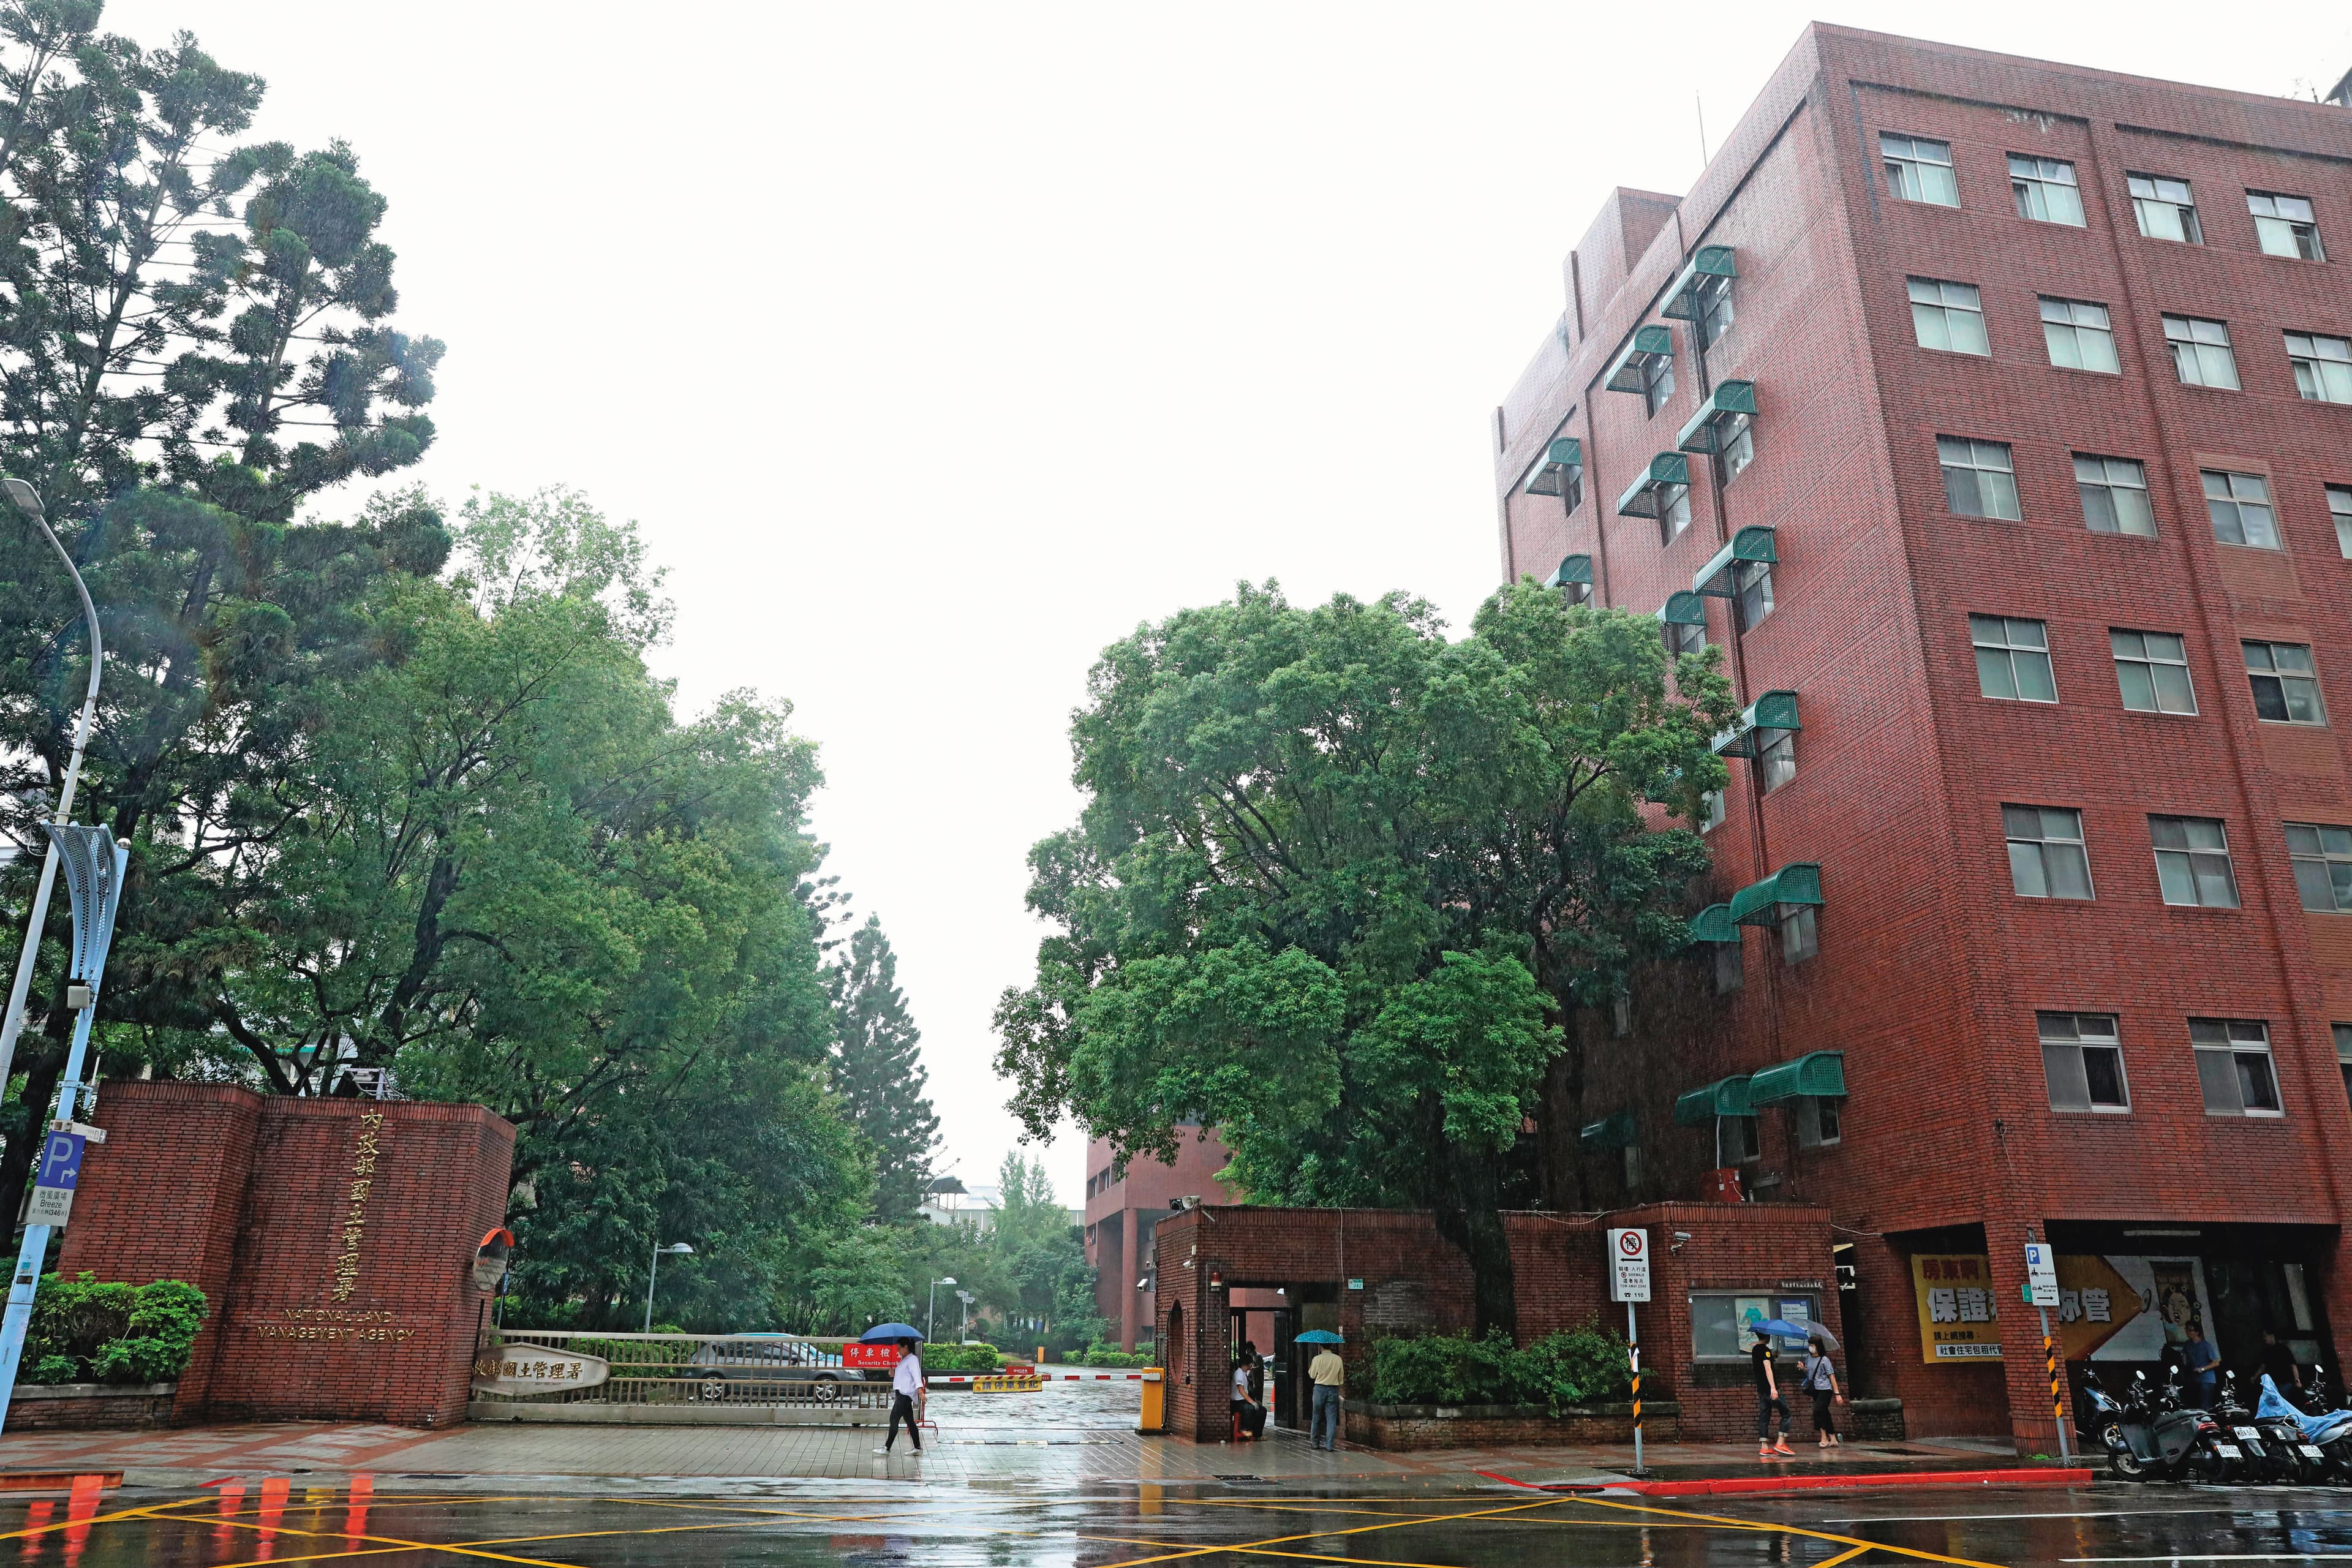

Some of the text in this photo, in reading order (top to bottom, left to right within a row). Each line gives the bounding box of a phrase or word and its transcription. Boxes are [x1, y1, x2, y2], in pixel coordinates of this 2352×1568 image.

[44, 1136, 73, 1177] P
[40, 1199, 62, 1208] Breeze
[331, 1109, 383, 1303] 內政部國土管理署
[1625, 1237, 1637, 1250] 停
[2029, 1250, 2037, 1262] P
[285, 1309, 393, 1323] NATIONAL LAND
[256, 1326, 415, 1341] MANAGEMENT AGENCY
